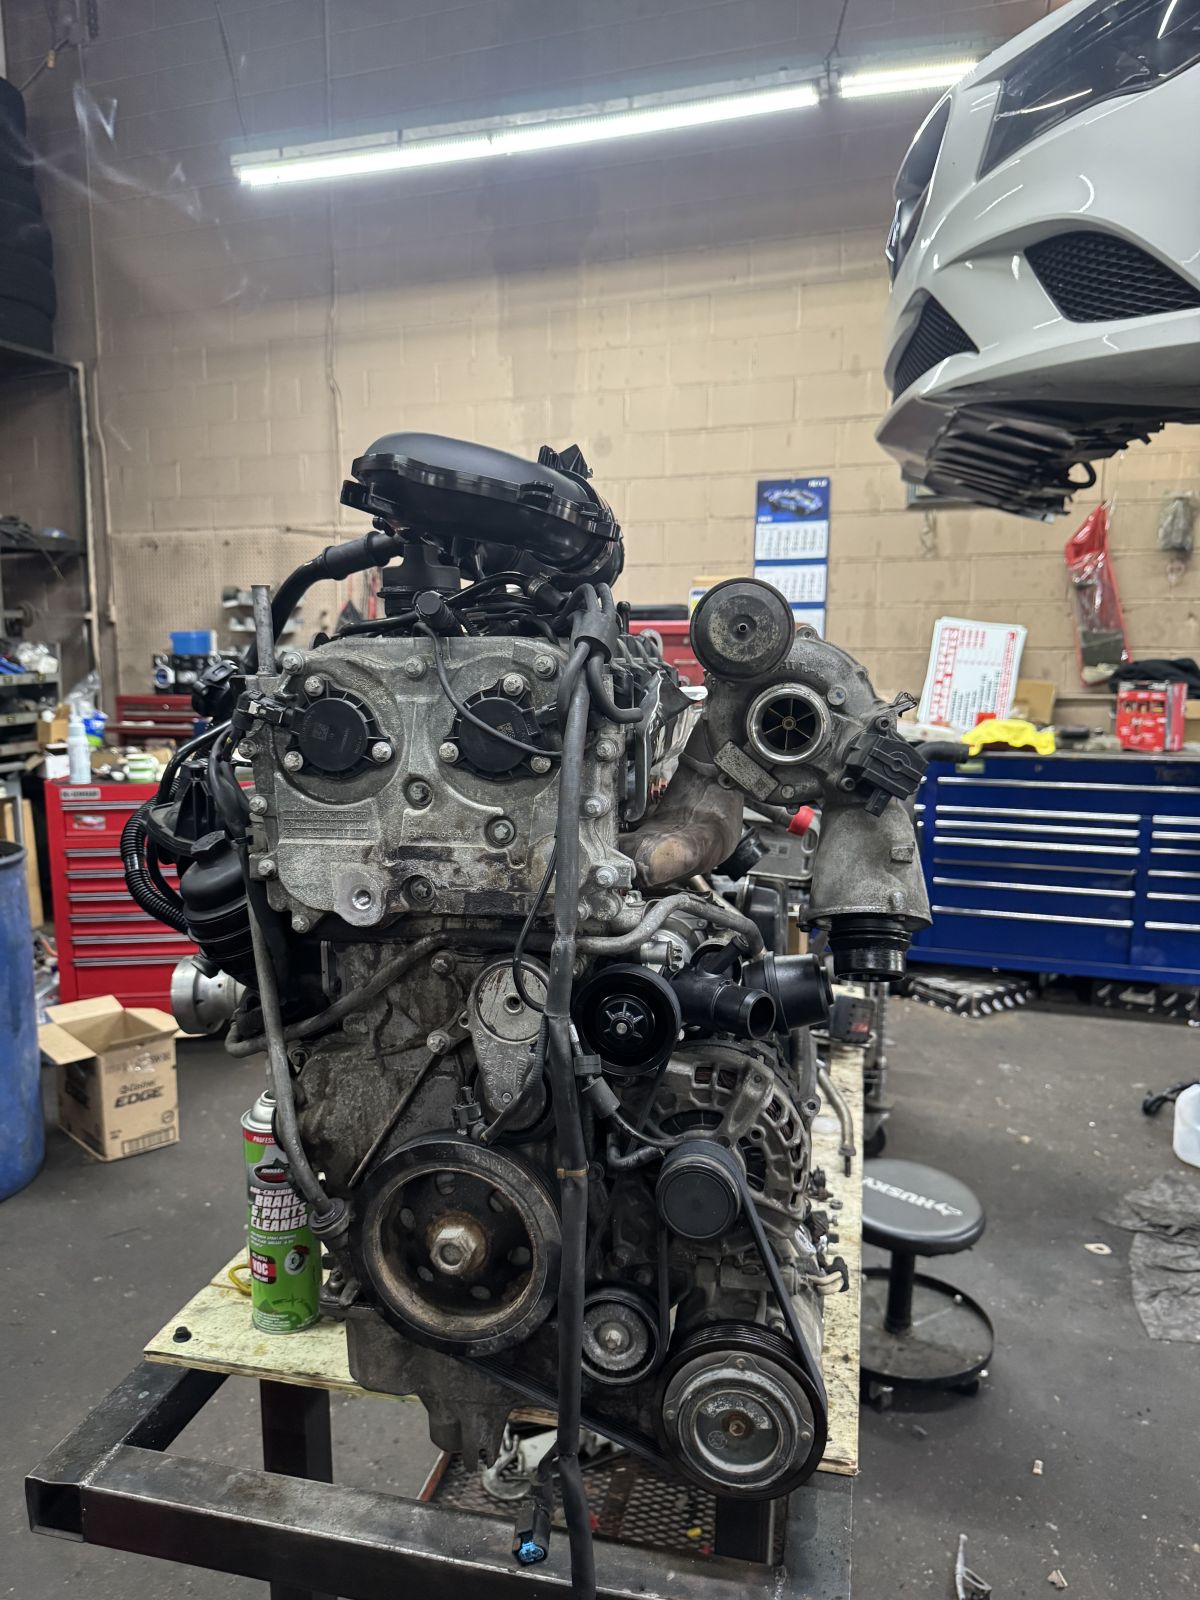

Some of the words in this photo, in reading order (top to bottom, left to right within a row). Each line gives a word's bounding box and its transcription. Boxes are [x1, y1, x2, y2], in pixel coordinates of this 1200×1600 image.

[116, 1086, 164, 1108] EDGE
[252, 1135, 277, 1144] PROFESS
[255, 1193, 301, 1208] BRAKE
[862, 1175, 936, 1210] HUSKY
[261, 1201, 308, 1220] PARTS
[250, 1214, 308, 1232] CLEANER
[252, 1258, 269, 1276] VOC
